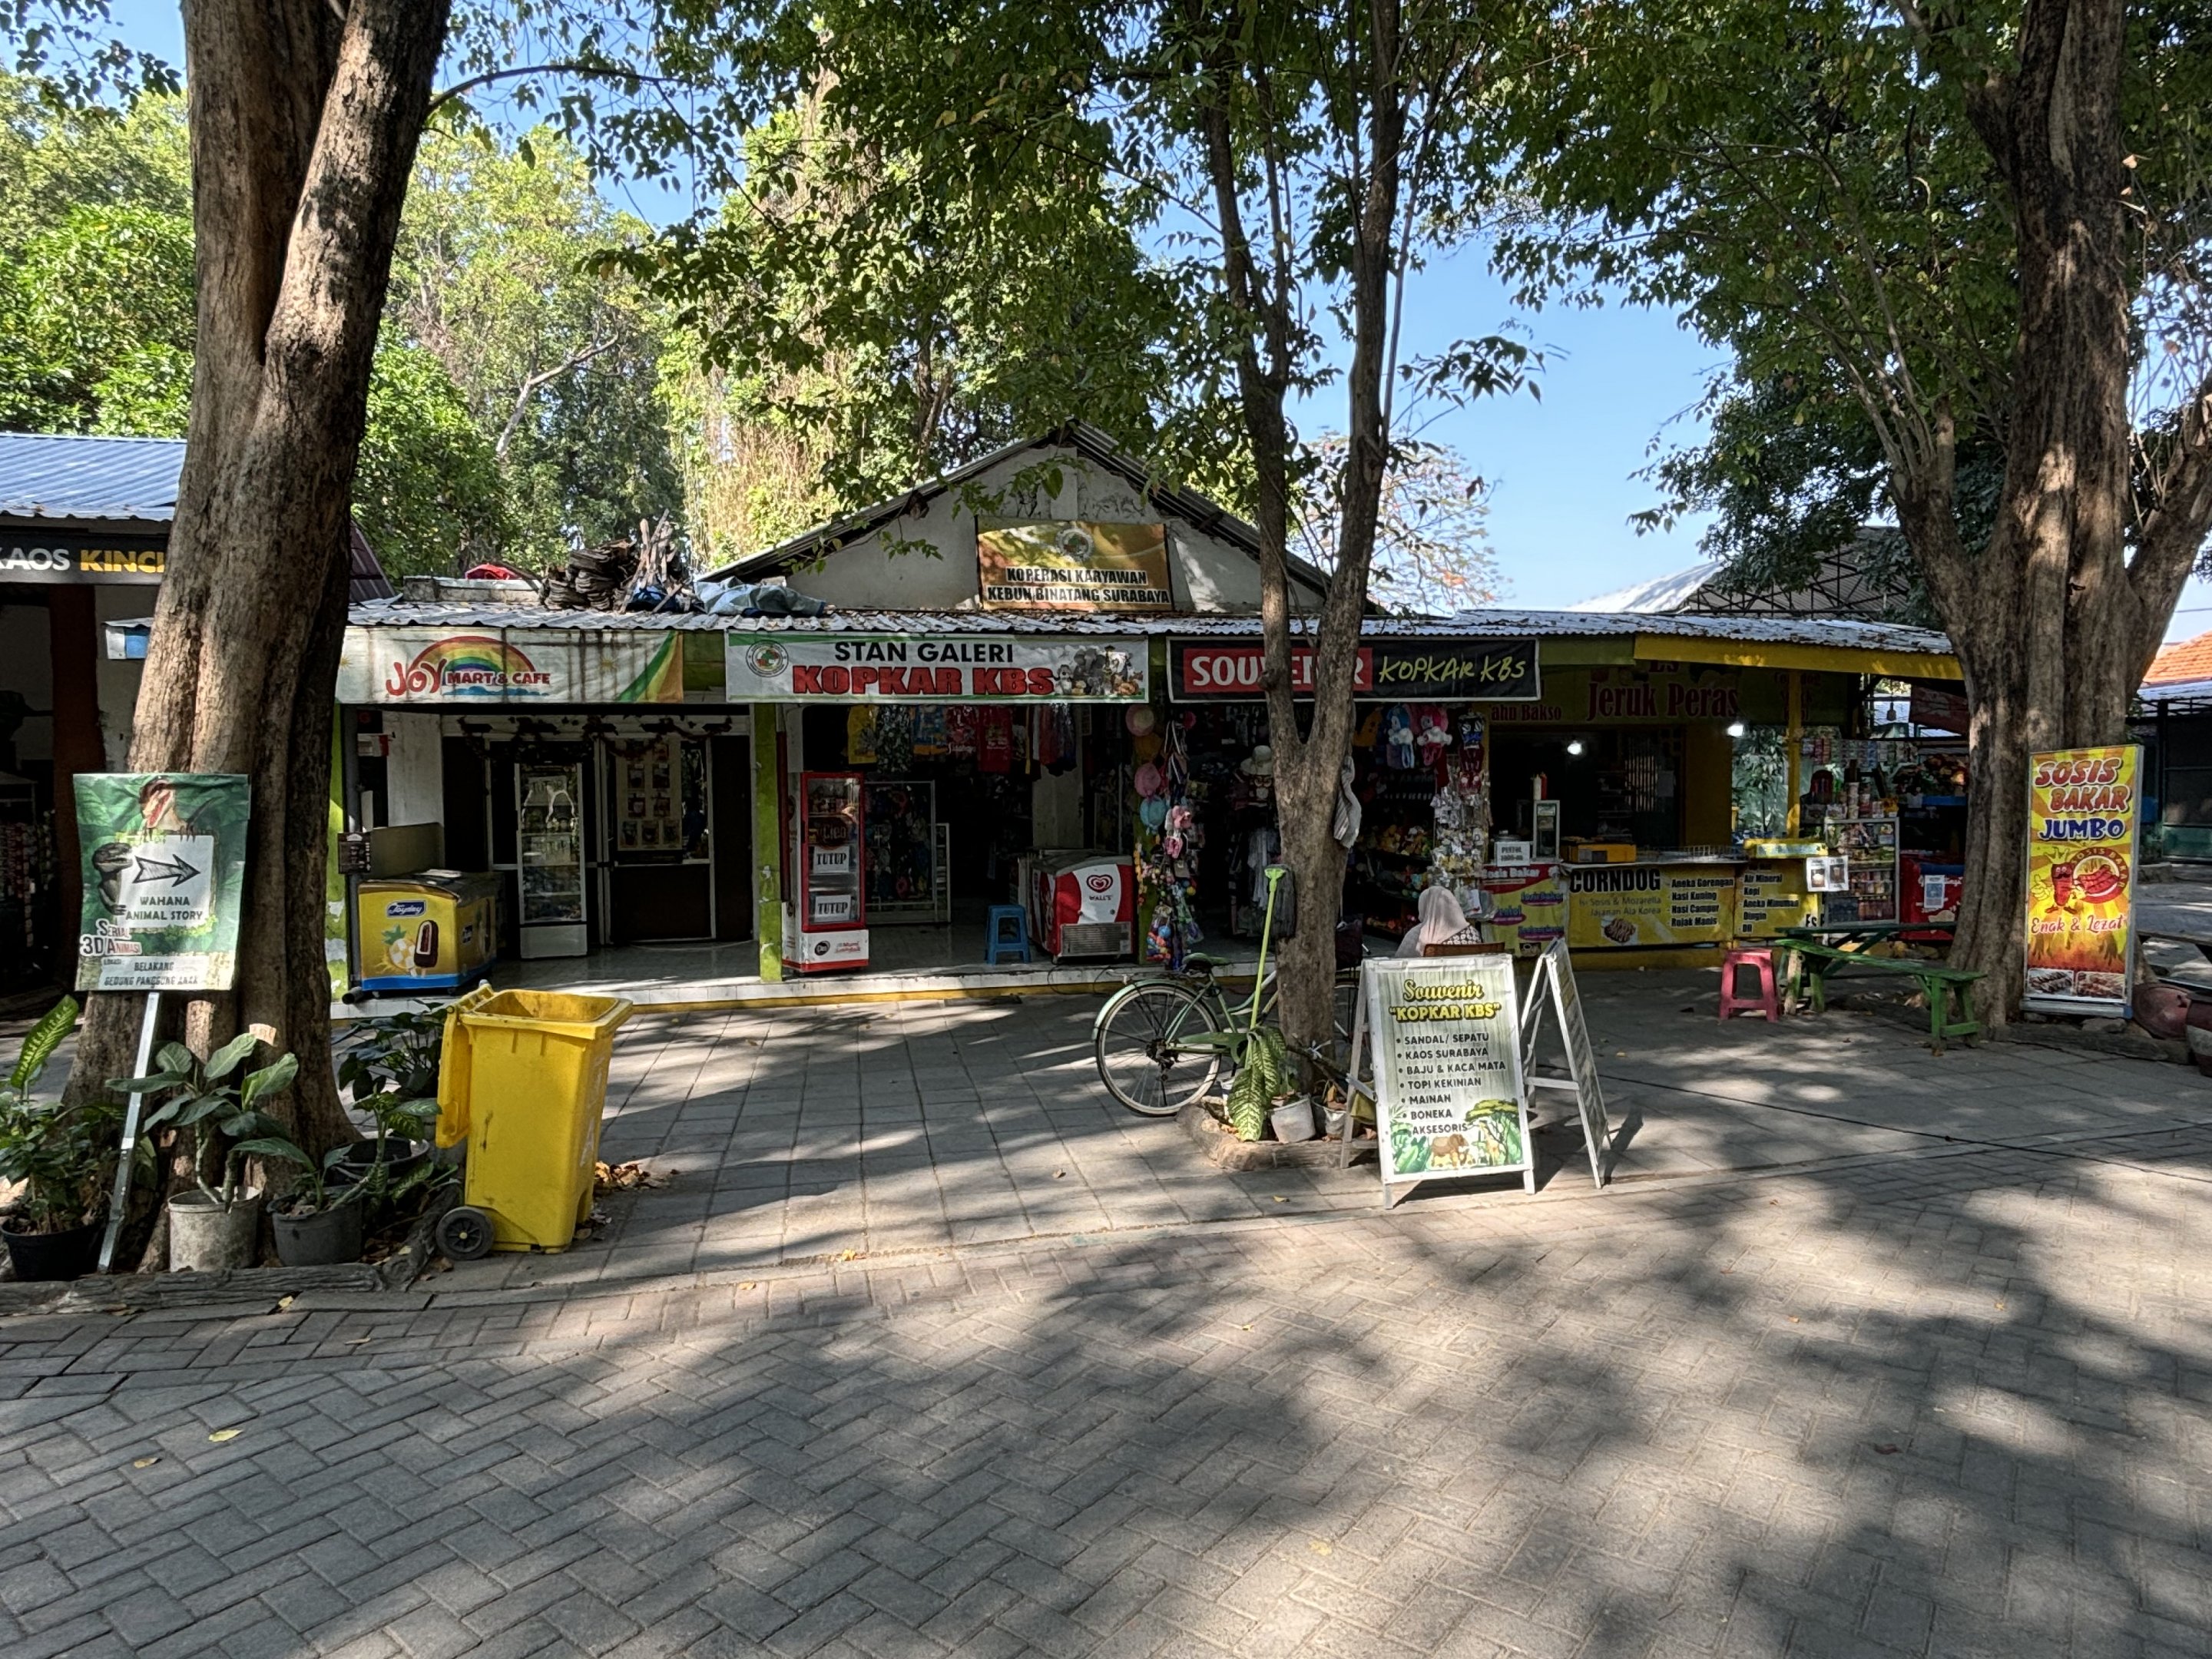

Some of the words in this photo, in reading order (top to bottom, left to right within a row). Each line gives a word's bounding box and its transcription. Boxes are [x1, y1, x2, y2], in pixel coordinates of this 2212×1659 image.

[1007, 568, 1072, 583] KOPERASI
[1075, 569, 1147, 584] KARYAWAN
[988, 587, 1032, 601] KEBUN
[1037, 588, 1101, 602] BINATANG
[1103, 589, 1171, 604] SURABAYA
[834, 642, 907, 662] STAN
[916, 643, 1014, 664] GALERI
[446, 672, 494, 686] MART
[497, 673, 508, 685] &
[512, 672, 551, 685] CAFE
[792, 665, 963, 695] KOPKAR
[972, 666, 1055, 695] KBS
[1586, 682, 1657, 721] Jeruk
[1665, 683, 1740, 718] Peras
[1489, 704, 1517, 721] ahu
[1522, 704, 1562, 721] Bakso
[2035, 757, 2122, 786] SOSIS
[2051, 786, 2131, 813] BAKAR
[2039, 818, 2125, 840] JUMBO
[816, 853, 847, 866] TUTUP
[1570, 869, 1661, 892] CORNDOG
[1672, 879, 1696, 888] Aneka
[1744, 874, 1754, 882] Air
[1756, 873, 1783, 882] Mineral
[1672, 892, 1689, 901] Nasi
[1743, 887, 1760, 896] Kopi
[140, 896, 190, 906] WAHANA
[1590, 898, 1611, 906] Sosis
[1622, 896, 1661, 905] Mozarella
[817, 902, 849, 915] TUTUP
[1672, 905, 1688, 913] Nasi
[1690, 905, 1720, 914] Campur
[125, 910, 167, 921] ANIMAL
[171, 910, 204, 920] STORY
[1695, 918, 1717, 926] Manis
[2031, 917, 2065, 934] Enak
[2071, 918, 2081, 932] &
[2086, 914, 2124, 932] Lezat
[83, 936, 104, 955] 3D
[134, 962, 175, 971] BELAKANG
[104, 976, 134, 986] GEDUNG
[1403, 979, 1485, 1002] Souvenir
[1404, 1035, 1449, 1045] SANDAL/
[1452, 1032, 1490, 1043] SEPATU
[1405, 1050, 1433, 1061] KAOS
[1435, 1048, 1489, 1058] SURABAYA
[1406, 1065, 1434, 1075] BAJU
[1437, 1065, 1444, 1073] &
[1447, 1062, 1476, 1073] KACA
[1479, 1061, 1506, 1071] MATA
[1408, 1079, 1432, 1090] TOPI
[1434, 1077, 1482, 1088] KEKINIAN
[1409, 1094, 1452, 1105] MAINAN
[1410, 1109, 1453, 1121] BONEKA
[1412, 1123, 1469, 1136] AKSESORIS
